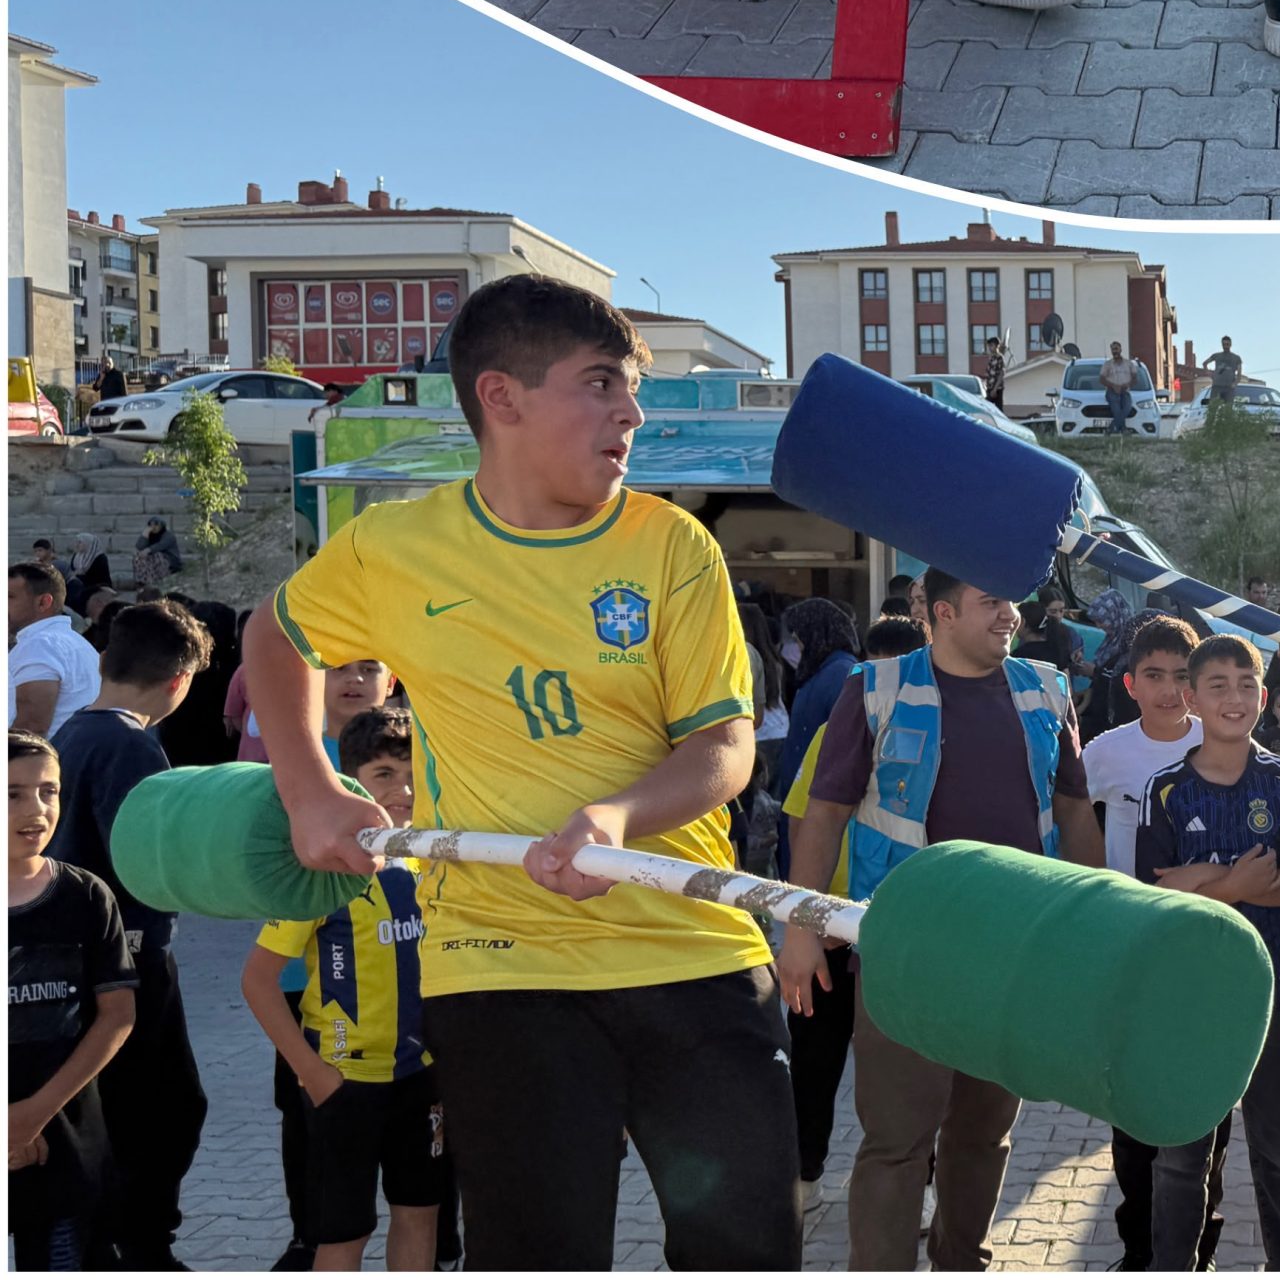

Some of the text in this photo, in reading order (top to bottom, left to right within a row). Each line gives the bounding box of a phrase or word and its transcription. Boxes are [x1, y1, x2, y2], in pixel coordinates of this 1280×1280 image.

[372, 297, 390, 307] sec
[436, 296, 453, 306] sec
[598, 652, 648, 664] BRASIL
[505, 665, 584, 740] 10
